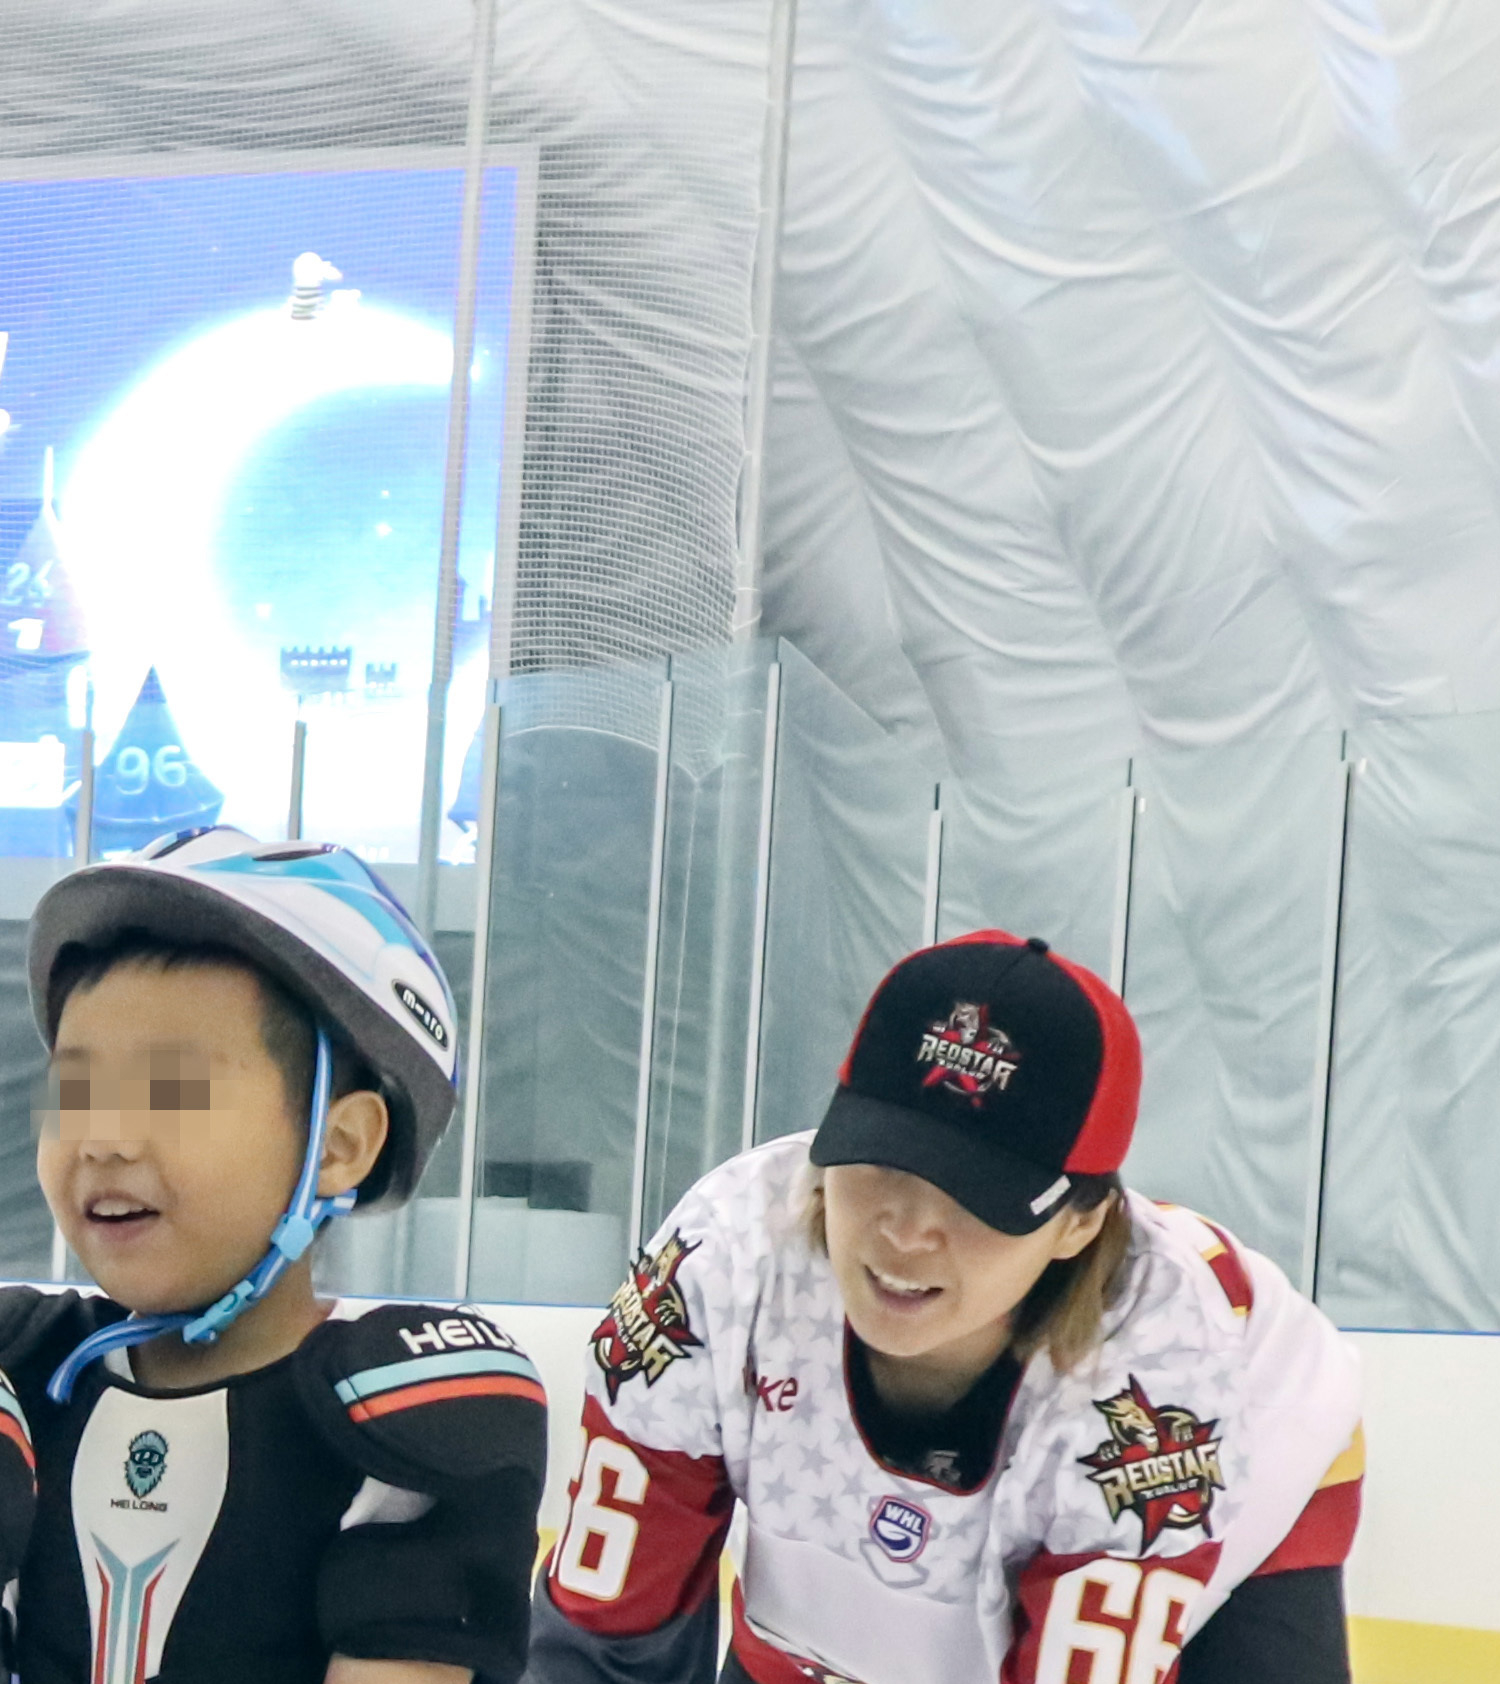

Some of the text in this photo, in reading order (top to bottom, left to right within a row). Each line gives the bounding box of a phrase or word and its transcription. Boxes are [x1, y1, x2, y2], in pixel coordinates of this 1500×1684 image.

[115, 745, 188, 795] 96
[917, 1033, 1019, 1091] REDSTAR
[1092, 1440, 1226, 1520] REDSTAR
[884, 1503, 924, 1534] WHL
